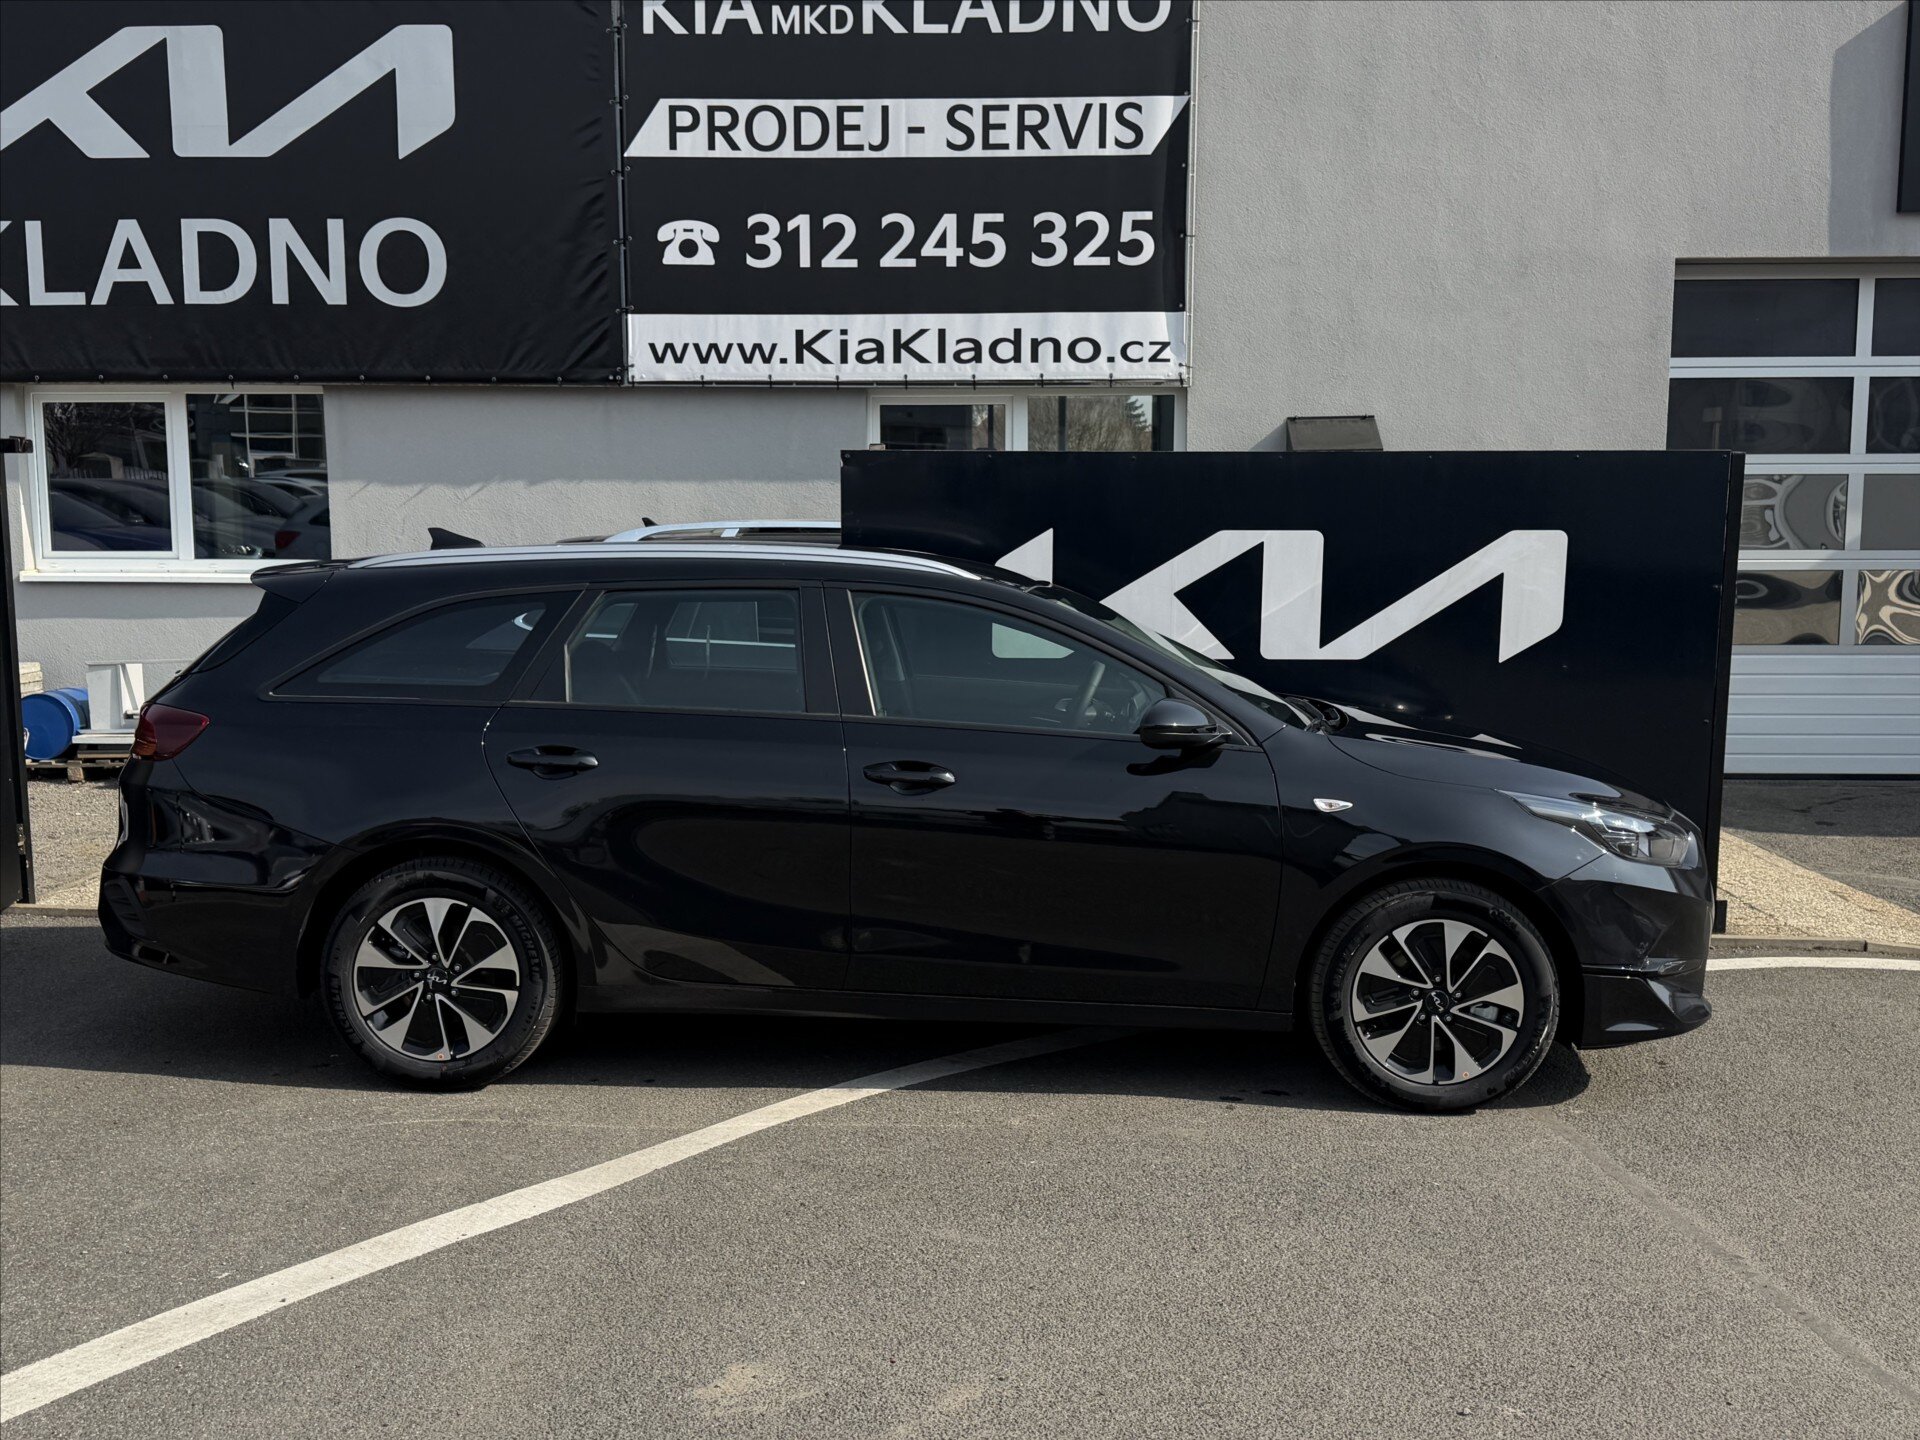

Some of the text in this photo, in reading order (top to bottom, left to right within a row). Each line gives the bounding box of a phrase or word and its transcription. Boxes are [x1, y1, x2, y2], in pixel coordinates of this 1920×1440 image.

[772, 5, 853, 34] MKD
[669, 105, 889, 151] PRODEJ
[947, 102, 1143, 151] SERVIS
[746, 211, 1155, 268] 312 245 325
[649, 329, 1170, 364] www.KiaKladno.cz
